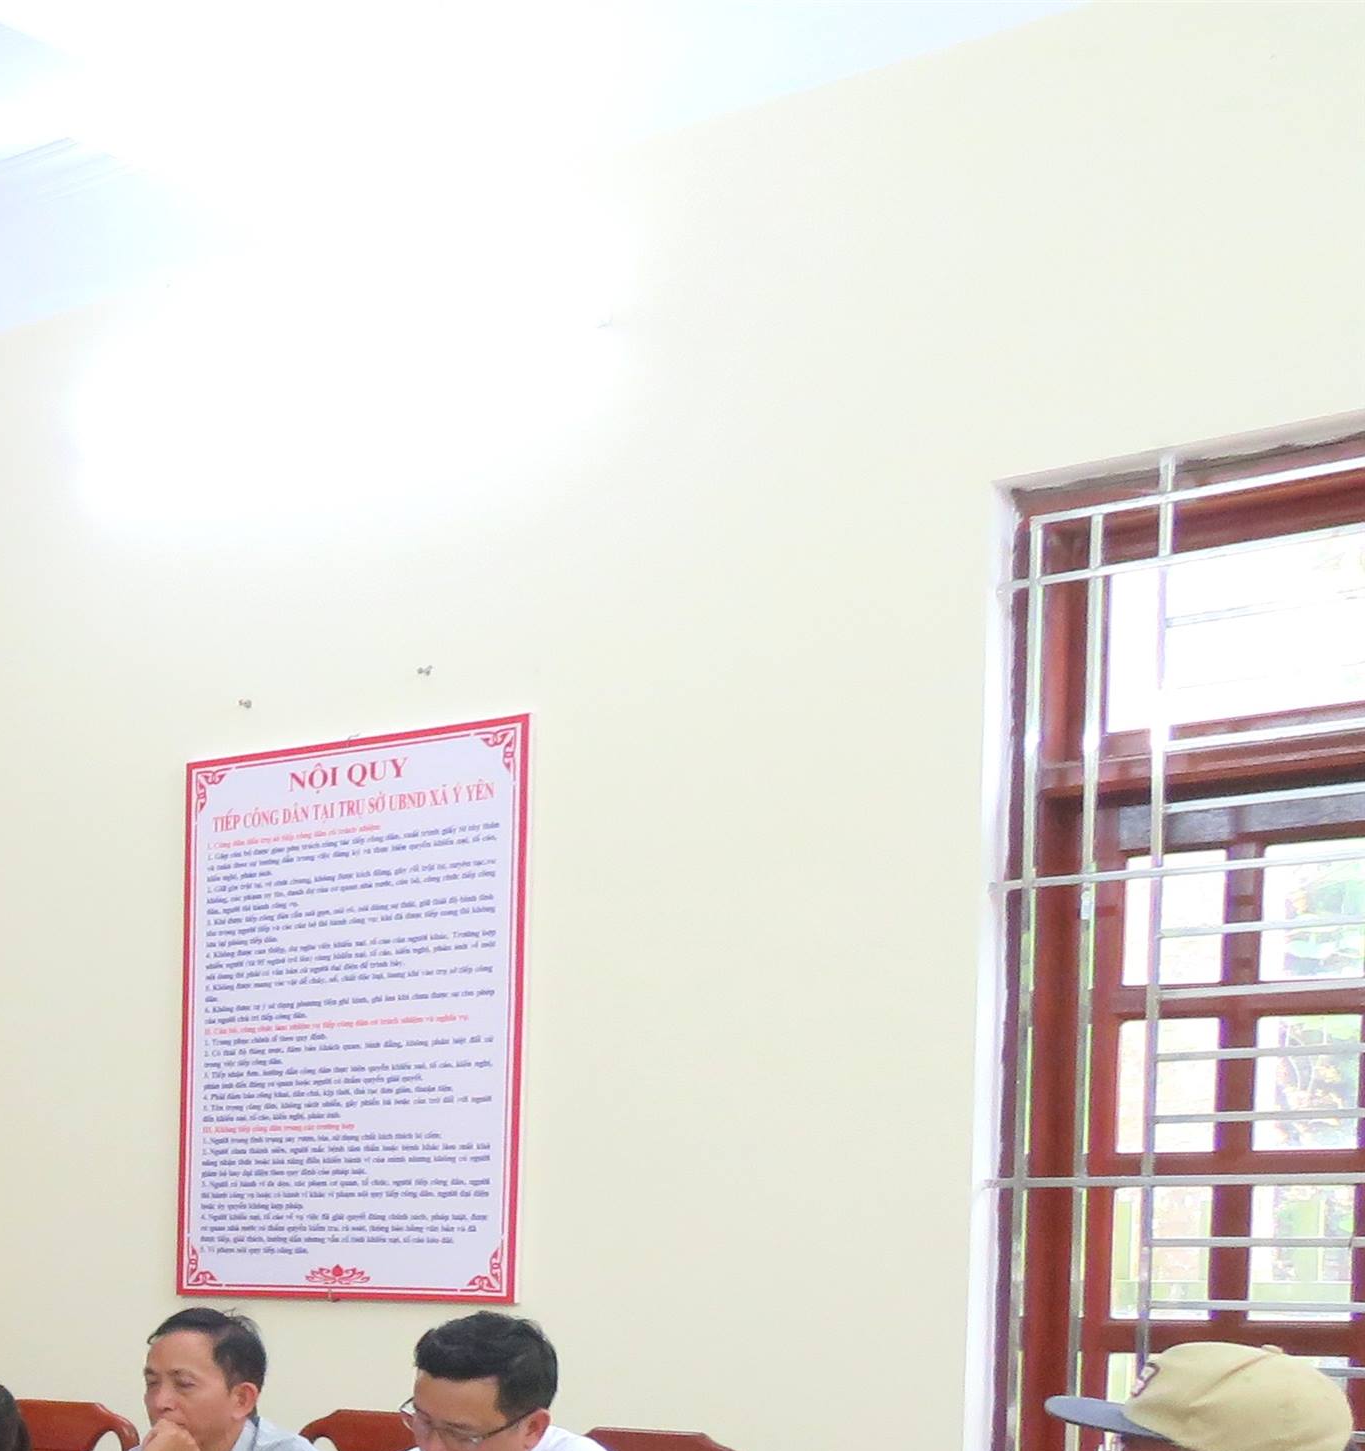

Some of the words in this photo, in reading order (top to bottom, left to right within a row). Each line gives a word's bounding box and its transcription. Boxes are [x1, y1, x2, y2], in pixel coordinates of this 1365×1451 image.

[289, 762, 339, 794] NỘI
[347, 756, 408, 787] QUY
[213, 808, 241, 833] TIẾP
[282, 802, 309, 825] DÂN
[313, 801, 336, 824] TẠI
[389, 791, 426, 811] UBND
[466, 779, 495, 802] YÊN
